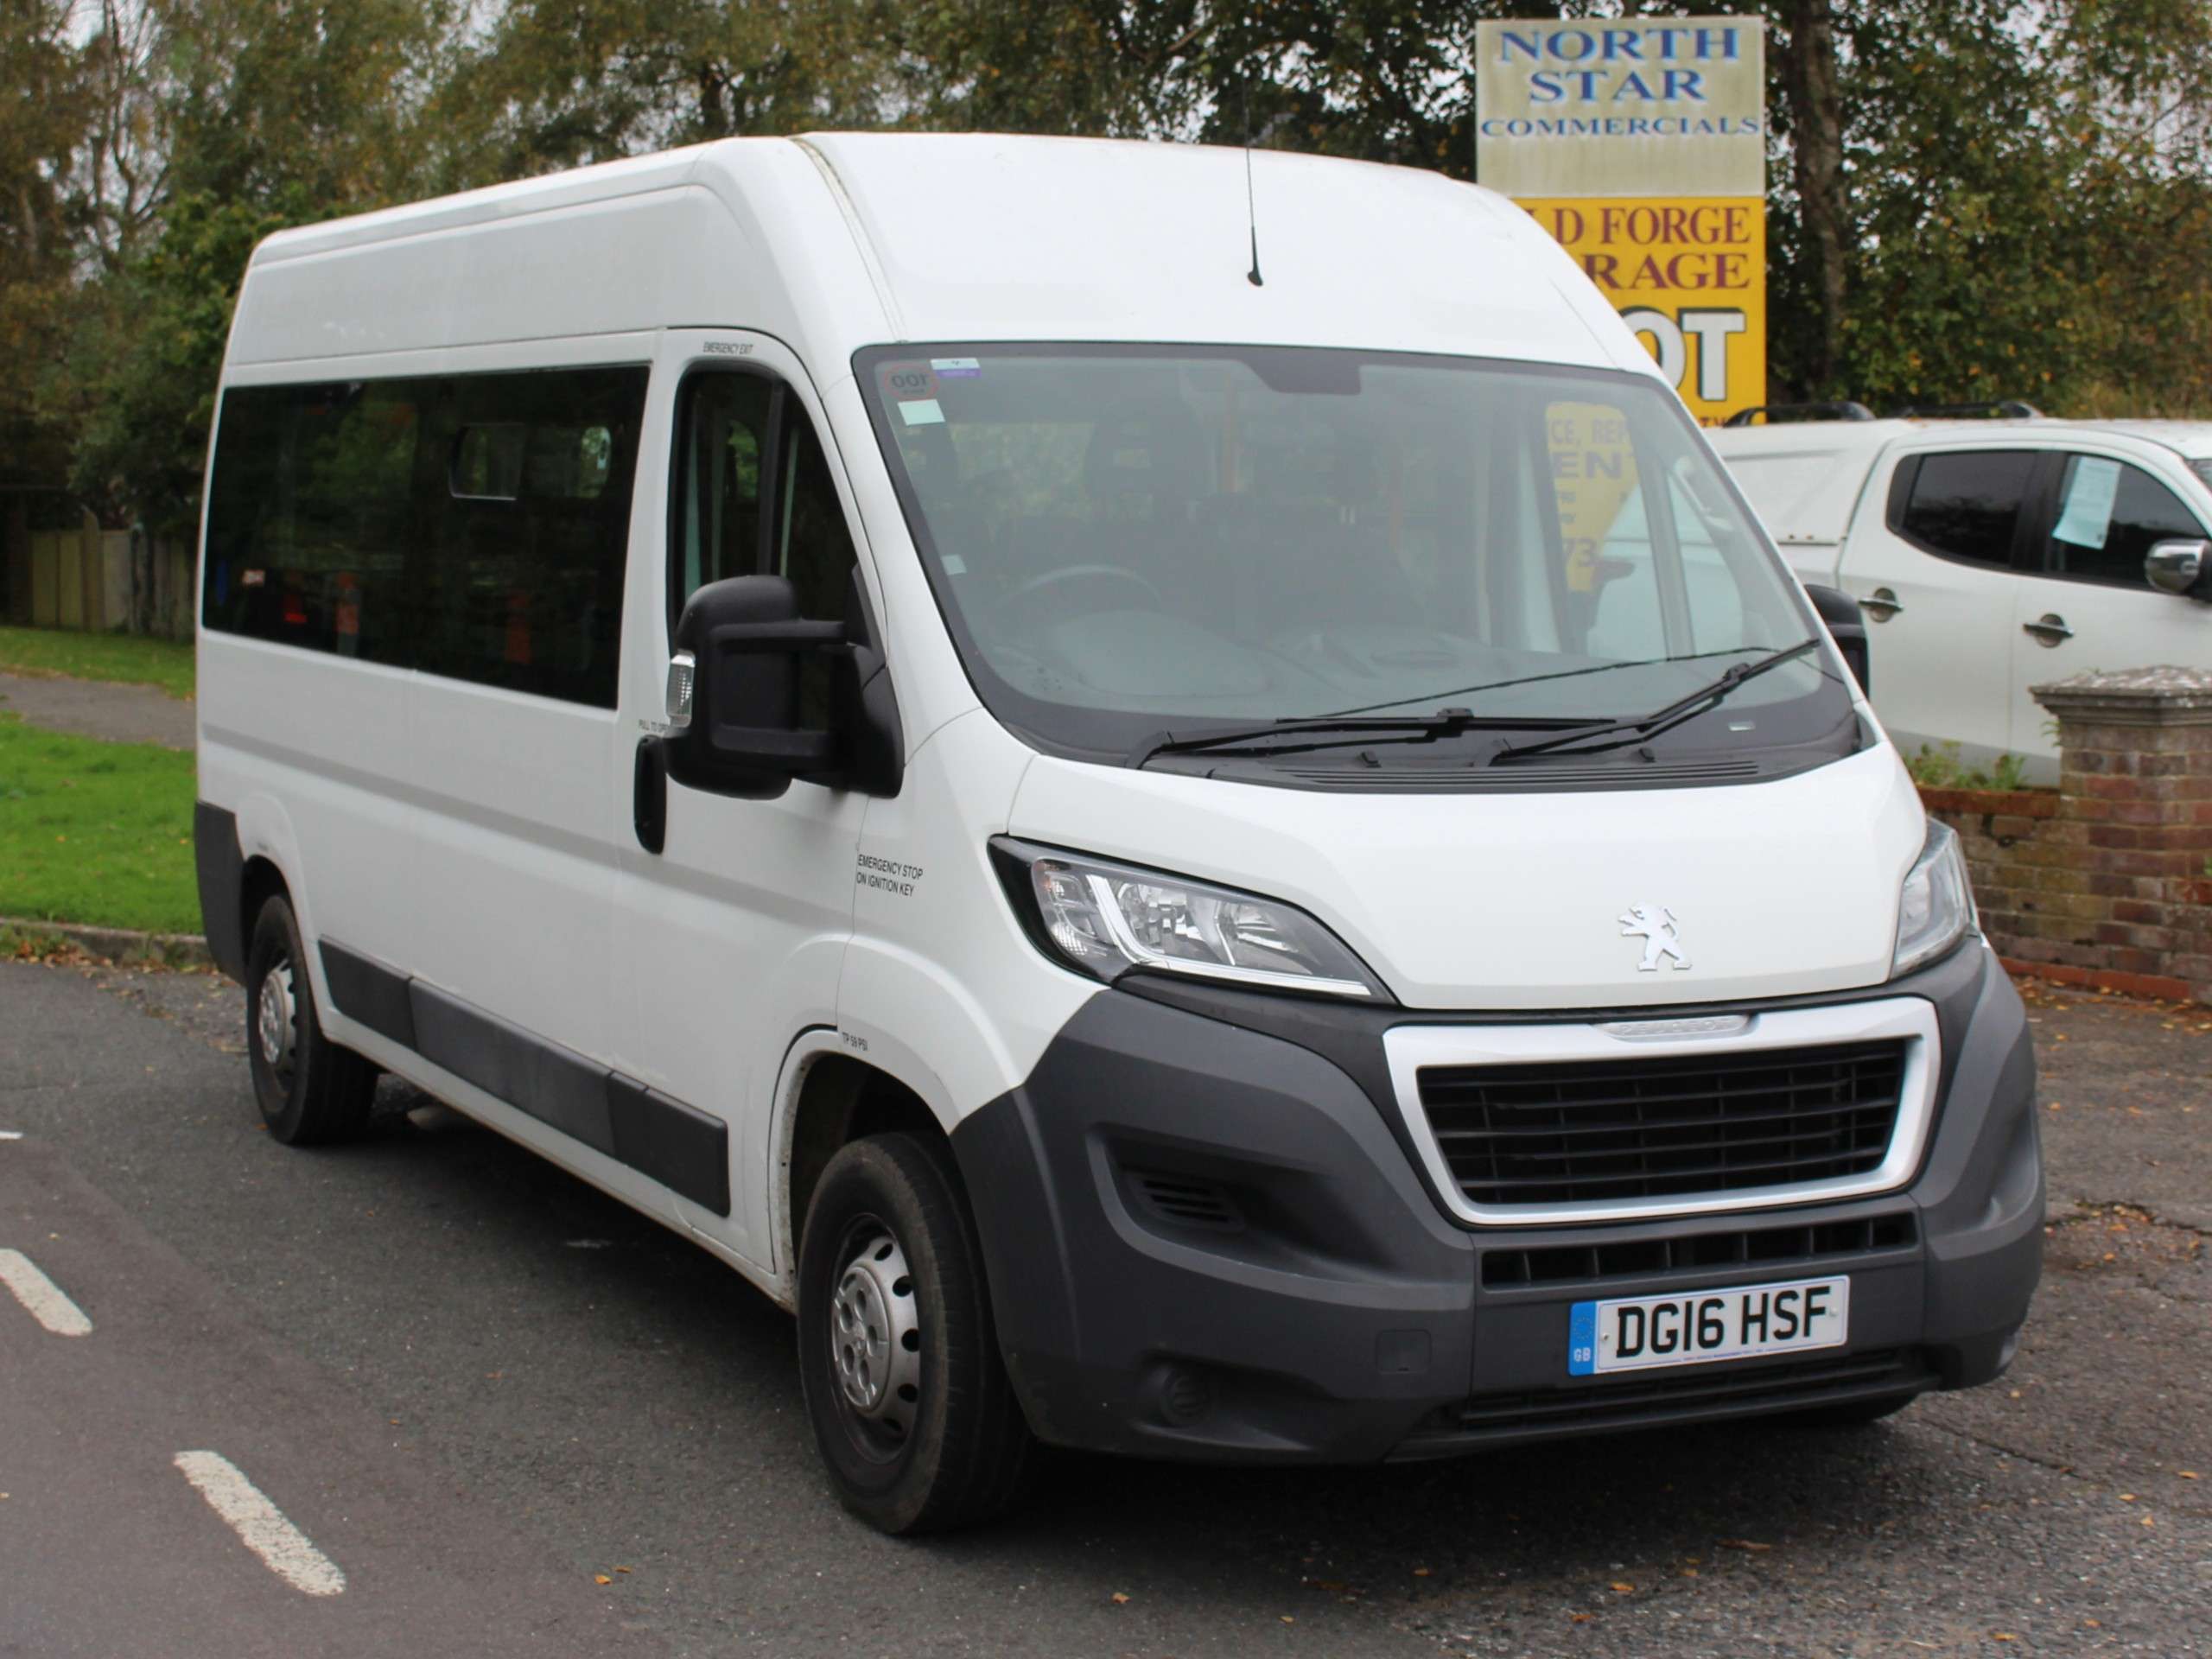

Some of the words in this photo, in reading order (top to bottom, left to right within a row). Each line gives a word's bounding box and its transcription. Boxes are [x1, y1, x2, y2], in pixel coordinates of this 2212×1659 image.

[1499, 28, 1739, 62] NORTH
[1529, 68, 1707, 103] STAR
[1480, 117, 1760, 137] COMMERCIALS
[1599, 206, 1751, 245] FORGE
[857, 854, 902, 876] EMERGENCY
[902, 864, 923, 880] STOP
[856, 872, 867, 885] ON
[868, 874, 899, 893] IGNITION
[899, 883, 914, 897] KEY
[1616, 1298, 1726, 1359] DG16
[1740, 1286, 1831, 1345] HSF
[1573, 1346, 1591, 1363] GB
